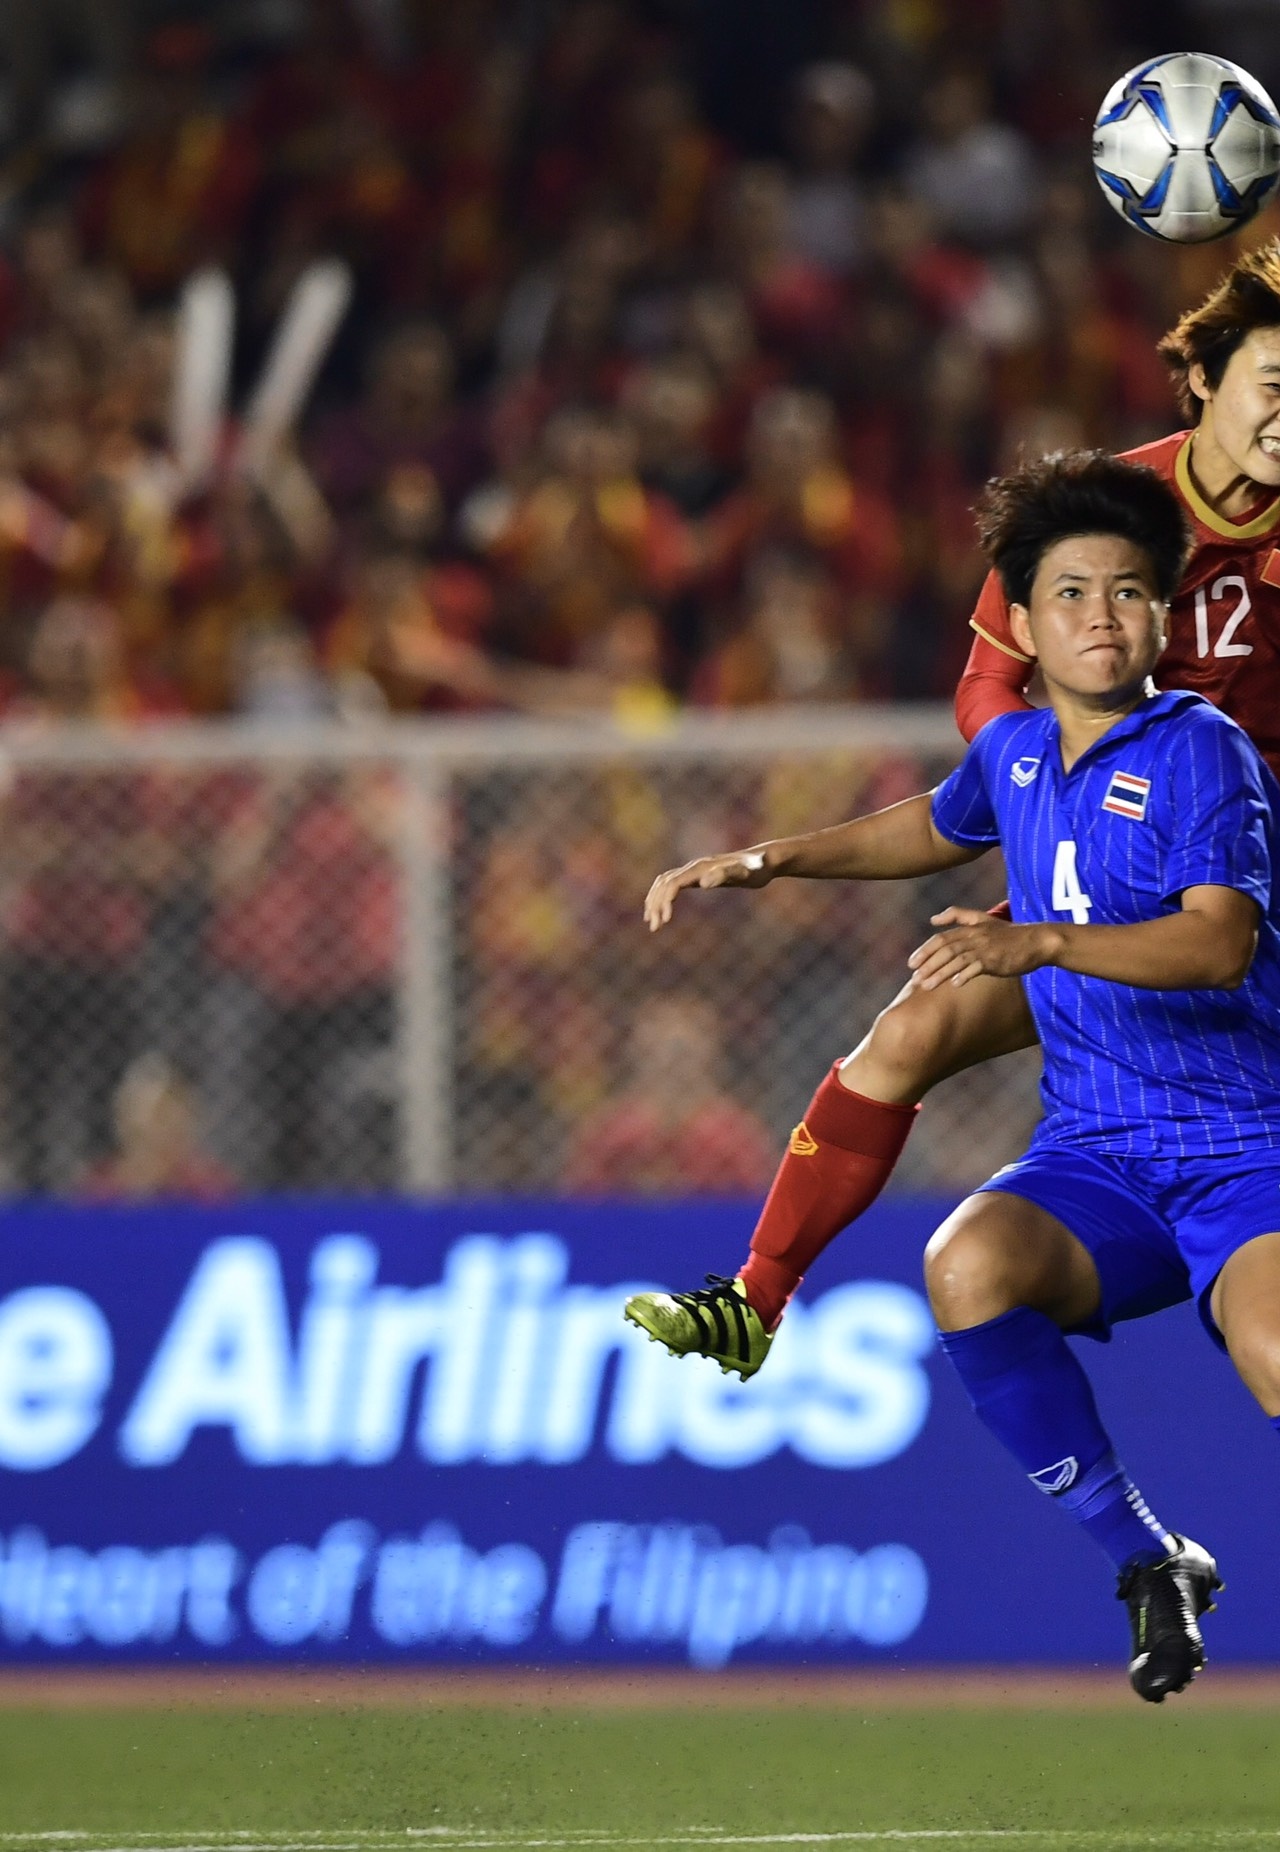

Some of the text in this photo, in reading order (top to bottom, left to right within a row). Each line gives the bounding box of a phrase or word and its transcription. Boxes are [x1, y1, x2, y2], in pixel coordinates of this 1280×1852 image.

[1193, 575, 1254, 660] 12
[1051, 839, 1093, 925] 4
[248, 1518, 374, 1645] of
